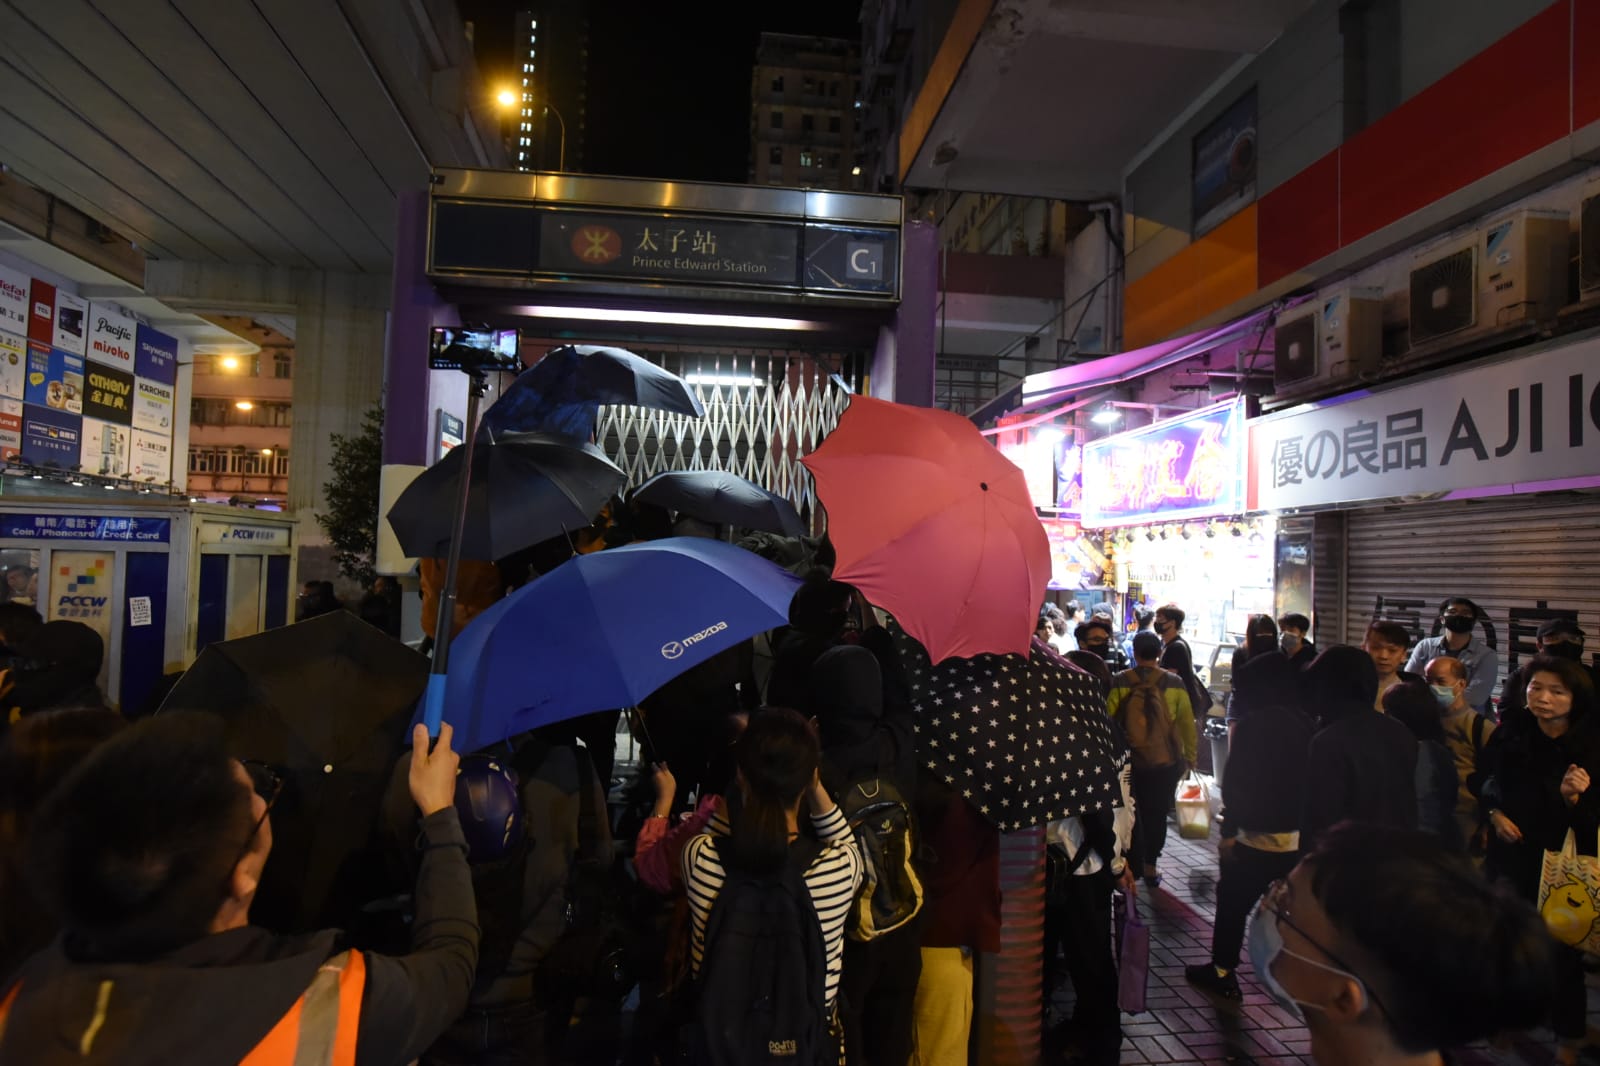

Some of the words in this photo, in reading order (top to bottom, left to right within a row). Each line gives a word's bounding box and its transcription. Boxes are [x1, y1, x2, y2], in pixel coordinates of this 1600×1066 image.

[635, 227, 717, 255] 太子站
[632, 255, 671, 268] Prince
[674, 257, 720, 271] Edward
[723, 261, 767, 274] Station
[851, 248, 876, 274] C1
[94, 317, 132, 341] Pacific
[93, 340, 130, 361] misoko
[1440, 382, 1543, 466] AJI
[1568, 373, 1600, 448] I
[1271, 407, 1428, 489] 優の良品
[12, 527, 34, 536] Coin
[42, 529, 95, 538] Phonecard
[103, 531, 134, 539] Credit
[136, 532, 159, 540] Card
[232, 529, 255, 539] PCCW
[58, 596, 107, 607] PCCW
[682, 621, 728, 648] mazda
